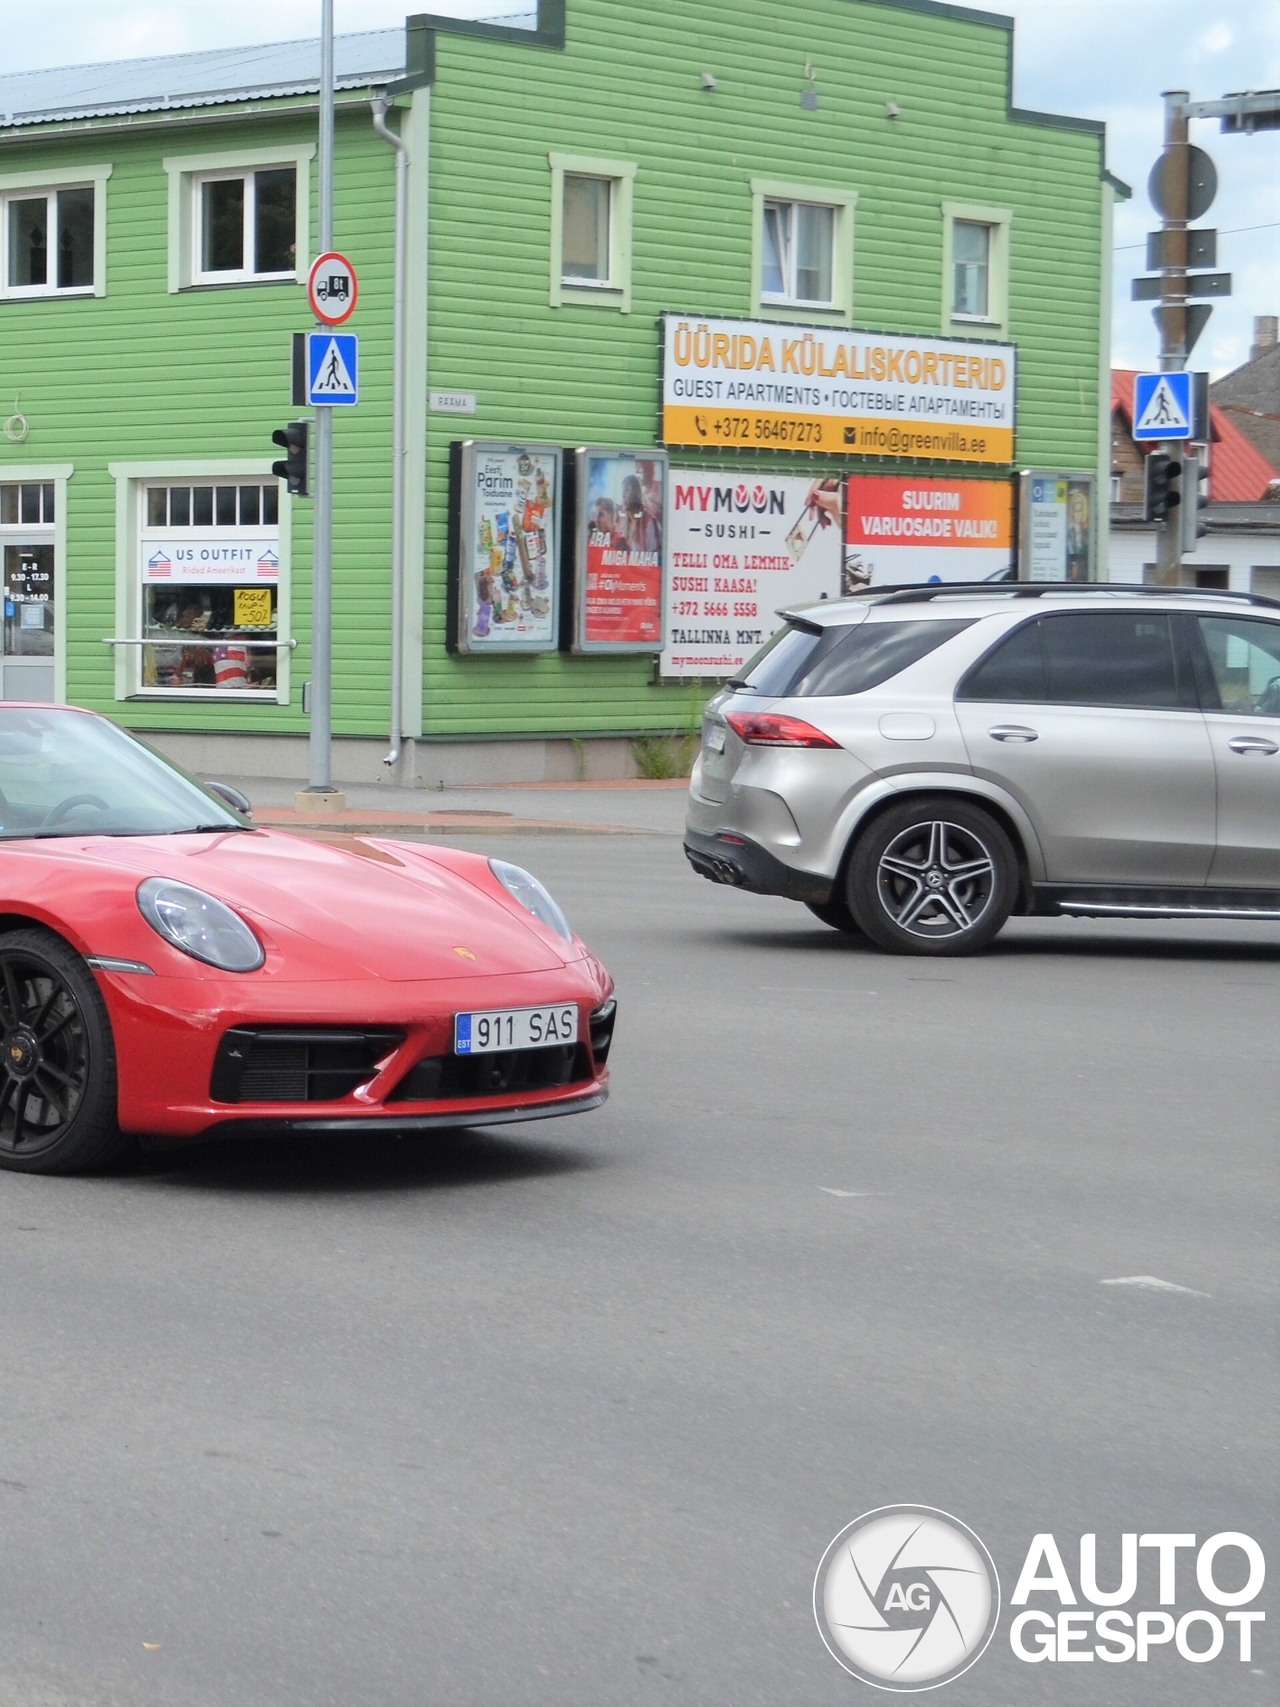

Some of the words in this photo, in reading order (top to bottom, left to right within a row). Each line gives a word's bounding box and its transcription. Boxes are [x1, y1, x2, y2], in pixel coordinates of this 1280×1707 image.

[334, 278, 344, 290] 8t
[674, 322, 776, 372] ÜÜRIDA
[781, 333, 1007, 391] KÜLALISKORTERID
[673, 378, 723, 399] GUEST
[726, 382, 820, 406] APARTMENTS
[832, 389, 905, 412] ГОСТЕВЫЕ
[908, 395, 1005, 420] АПАРТАМЕНТЫ
[713, 417, 749, 438] +372
[755, 418, 822, 443] 56467273
[860, 426, 986, 453] info@greenvilla.ee
[477, 472, 513, 488] Parim
[902, 490, 960, 511] SUURIM
[705, 524, 756, 539] SUSHI
[861, 516, 952, 538] VARUOSADE
[954, 519, 998, 539] VALIK!
[176, 549, 194, 560] US
[200, 549, 253, 560] OUTFIT
[628, 551, 659, 567] MAHA
[672, 552, 707, 569] TELLI
[713, 554, 739, 570] OMA
[744, 555, 794, 571] LEMMIK-
[182, 566, 205, 574] Riided
[206, 566, 246, 574] Ameerikast
[672, 576, 708, 592] SUSHI
[714, 577, 758, 593] KAASA!
[671, 601, 698, 616] +372
[704, 602, 728, 616] 5666
[733, 602, 758, 617] 5558
[671, 629, 731, 645] TALLINNA
[736, 630, 764, 645] MNT.
[671, 654, 744, 668] mymoonsushi.ee
[477, 1015, 513, 1047] 911
[529, 1009, 573, 1043] SAS
[458, 1040, 470, 1049] EST
